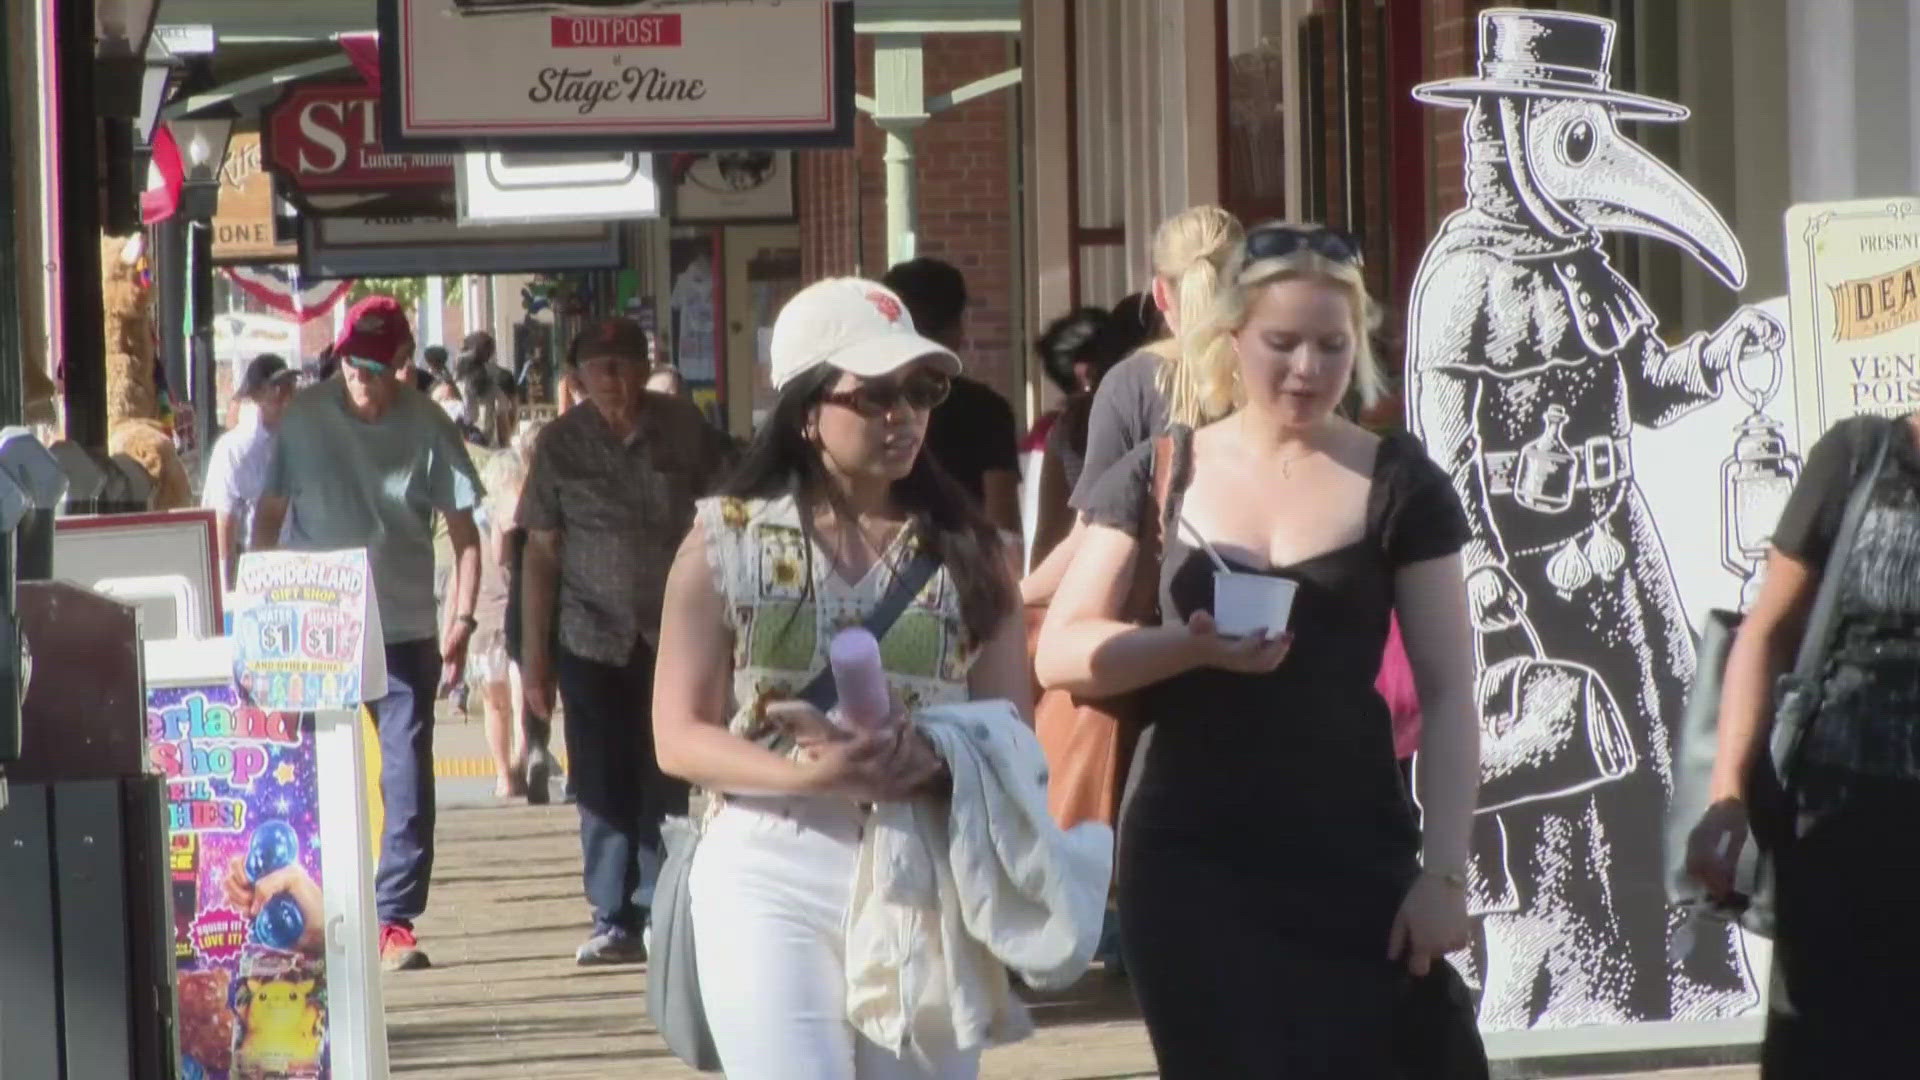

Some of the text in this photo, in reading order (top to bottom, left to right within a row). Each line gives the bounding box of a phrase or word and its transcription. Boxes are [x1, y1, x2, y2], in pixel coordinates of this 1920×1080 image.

[571, 17, 664, 44] OUTPOST
[528, 66, 706, 114] Stage Nine
[1855, 266, 1920, 321] DEA
[241, 562, 363, 594] WONDERLAND
[303, 587, 337, 601] SHOP
[263, 623, 290, 654] $1
[308, 626, 334, 656] $1
[199, 933, 242, 949] LOVE IT!
